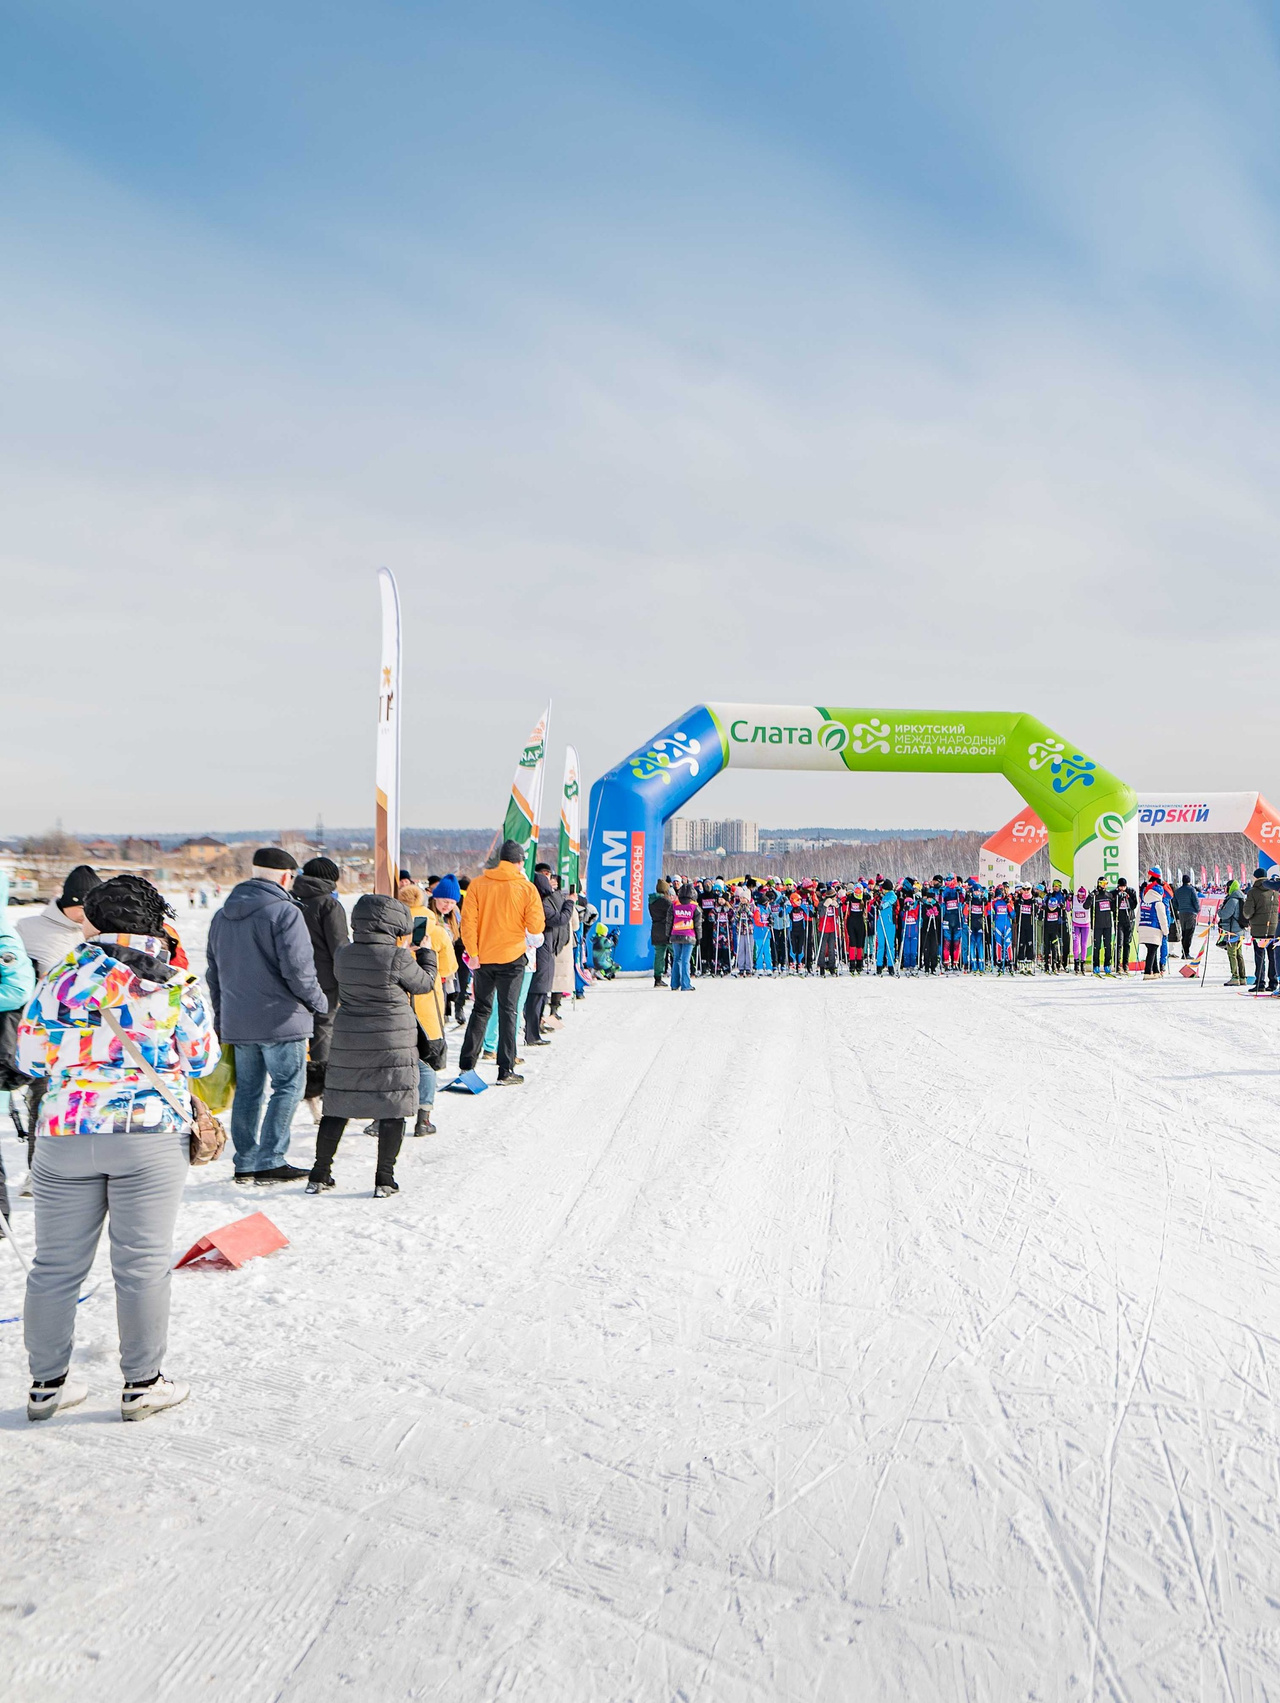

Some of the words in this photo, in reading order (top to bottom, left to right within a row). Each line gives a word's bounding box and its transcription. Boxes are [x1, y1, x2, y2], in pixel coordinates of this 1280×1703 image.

[730, 720, 812, 745] Слата
[894, 734, 1006, 746] МЕЖДУНАРОДНЫЙ
[895, 723, 966, 734] ИРКУТСКИЙ
[895, 745, 933, 755] СЛАТА
[936, 746, 996, 755] МАРАФОН
[600, 830, 627, 925] БАМ
[632, 845, 643, 911] МАРАФОНЫ
[1103, 845, 1119, 890] ата
